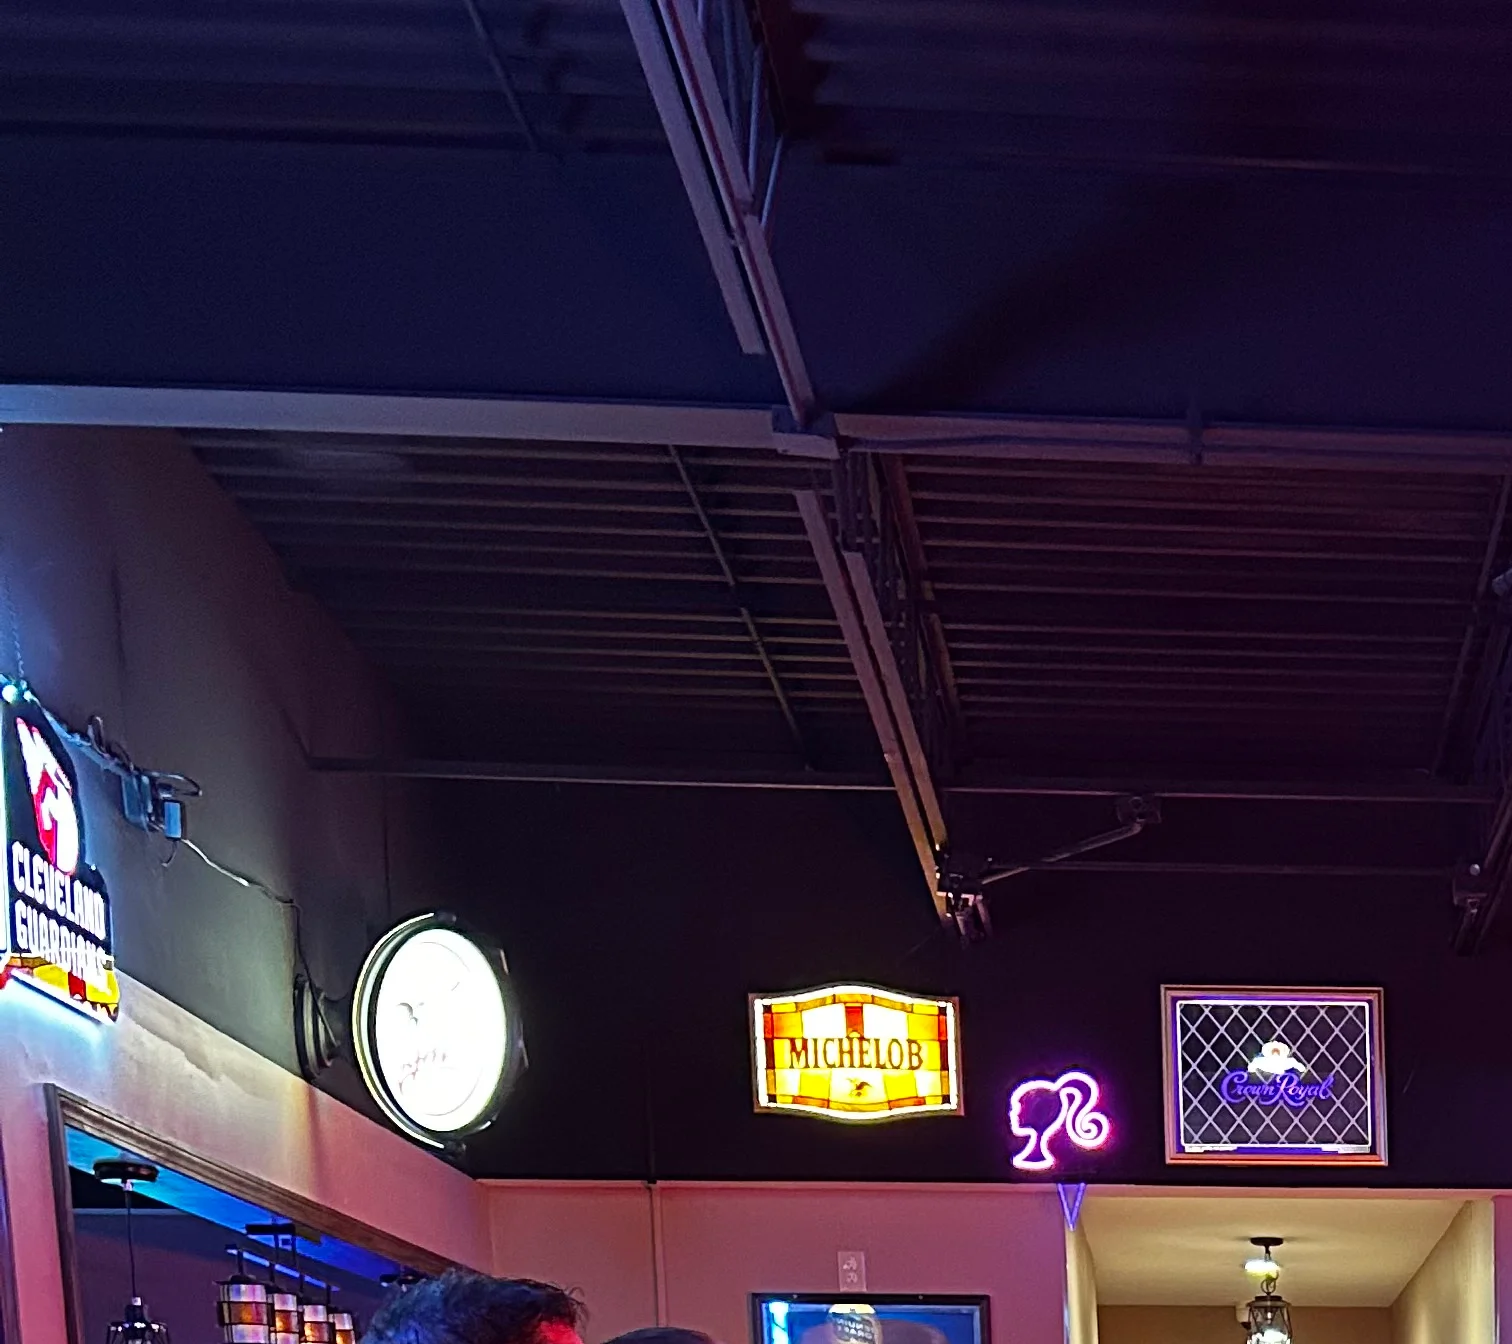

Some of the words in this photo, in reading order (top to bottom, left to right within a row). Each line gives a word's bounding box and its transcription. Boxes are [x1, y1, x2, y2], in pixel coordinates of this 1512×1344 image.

[12, 840, 108, 941] CLEVELAND
[15, 899, 112, 990] GUARDIANS
[789, 1038, 924, 1070] MICHELOB
[1221, 1070, 1275, 1103] Crown
[1259, 1072, 1335, 1107] Royal
